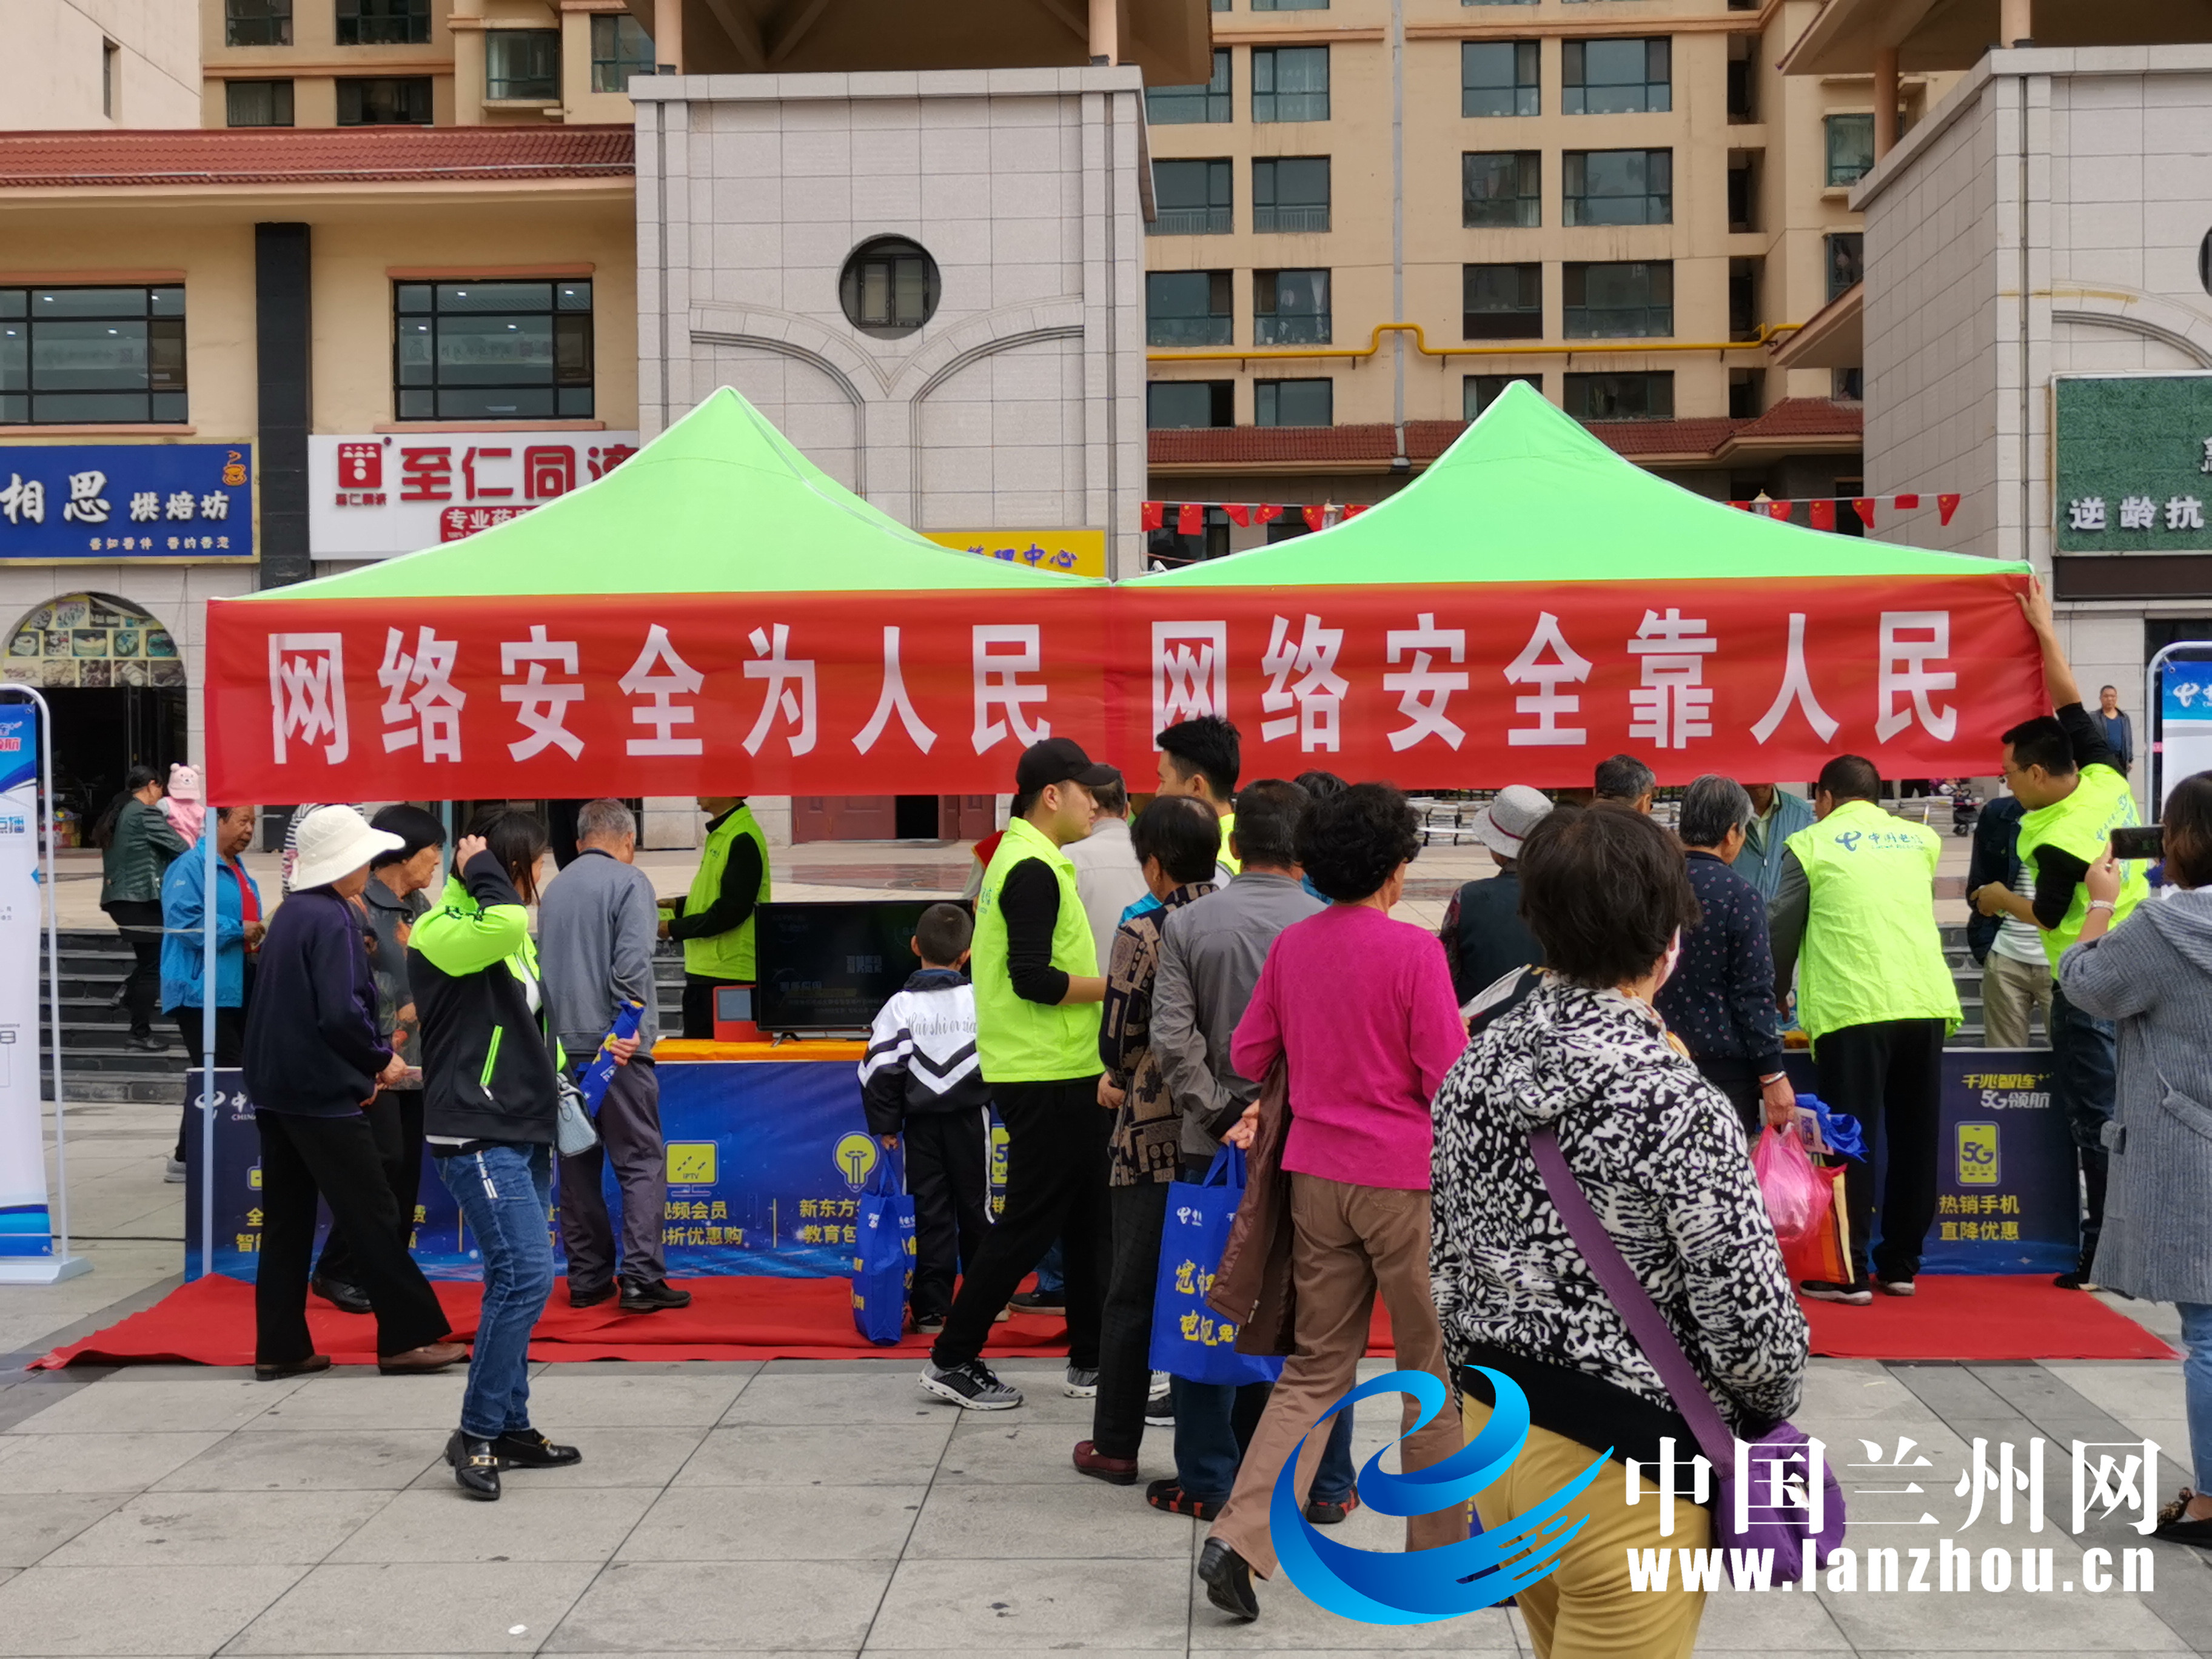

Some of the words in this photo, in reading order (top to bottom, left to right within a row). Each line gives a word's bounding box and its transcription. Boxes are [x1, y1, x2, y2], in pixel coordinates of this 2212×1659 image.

[0, 470, 112, 525] 相思
[130, 490, 230, 521] 烘焙坊
[2069, 495, 2205, 530] 逆龄抗
[267, 623, 1051, 765] 网络安全为人民
[1151, 608, 1959, 752] 网络安全靠人民
[1980, 1089, 2051, 1110] 5G领航
[994, 1143, 1008, 1163] 5
[1962, 1141, 1994, 1164] 5G
[799, 1198, 862, 1218] 新东方
[1939, 1194, 2020, 1215] 热销手机
[803, 1224, 857, 1244] 教育包
[1940, 1221, 2019, 1241] 直降优惠
[1179, 1309, 1241, 1346] 电视免
